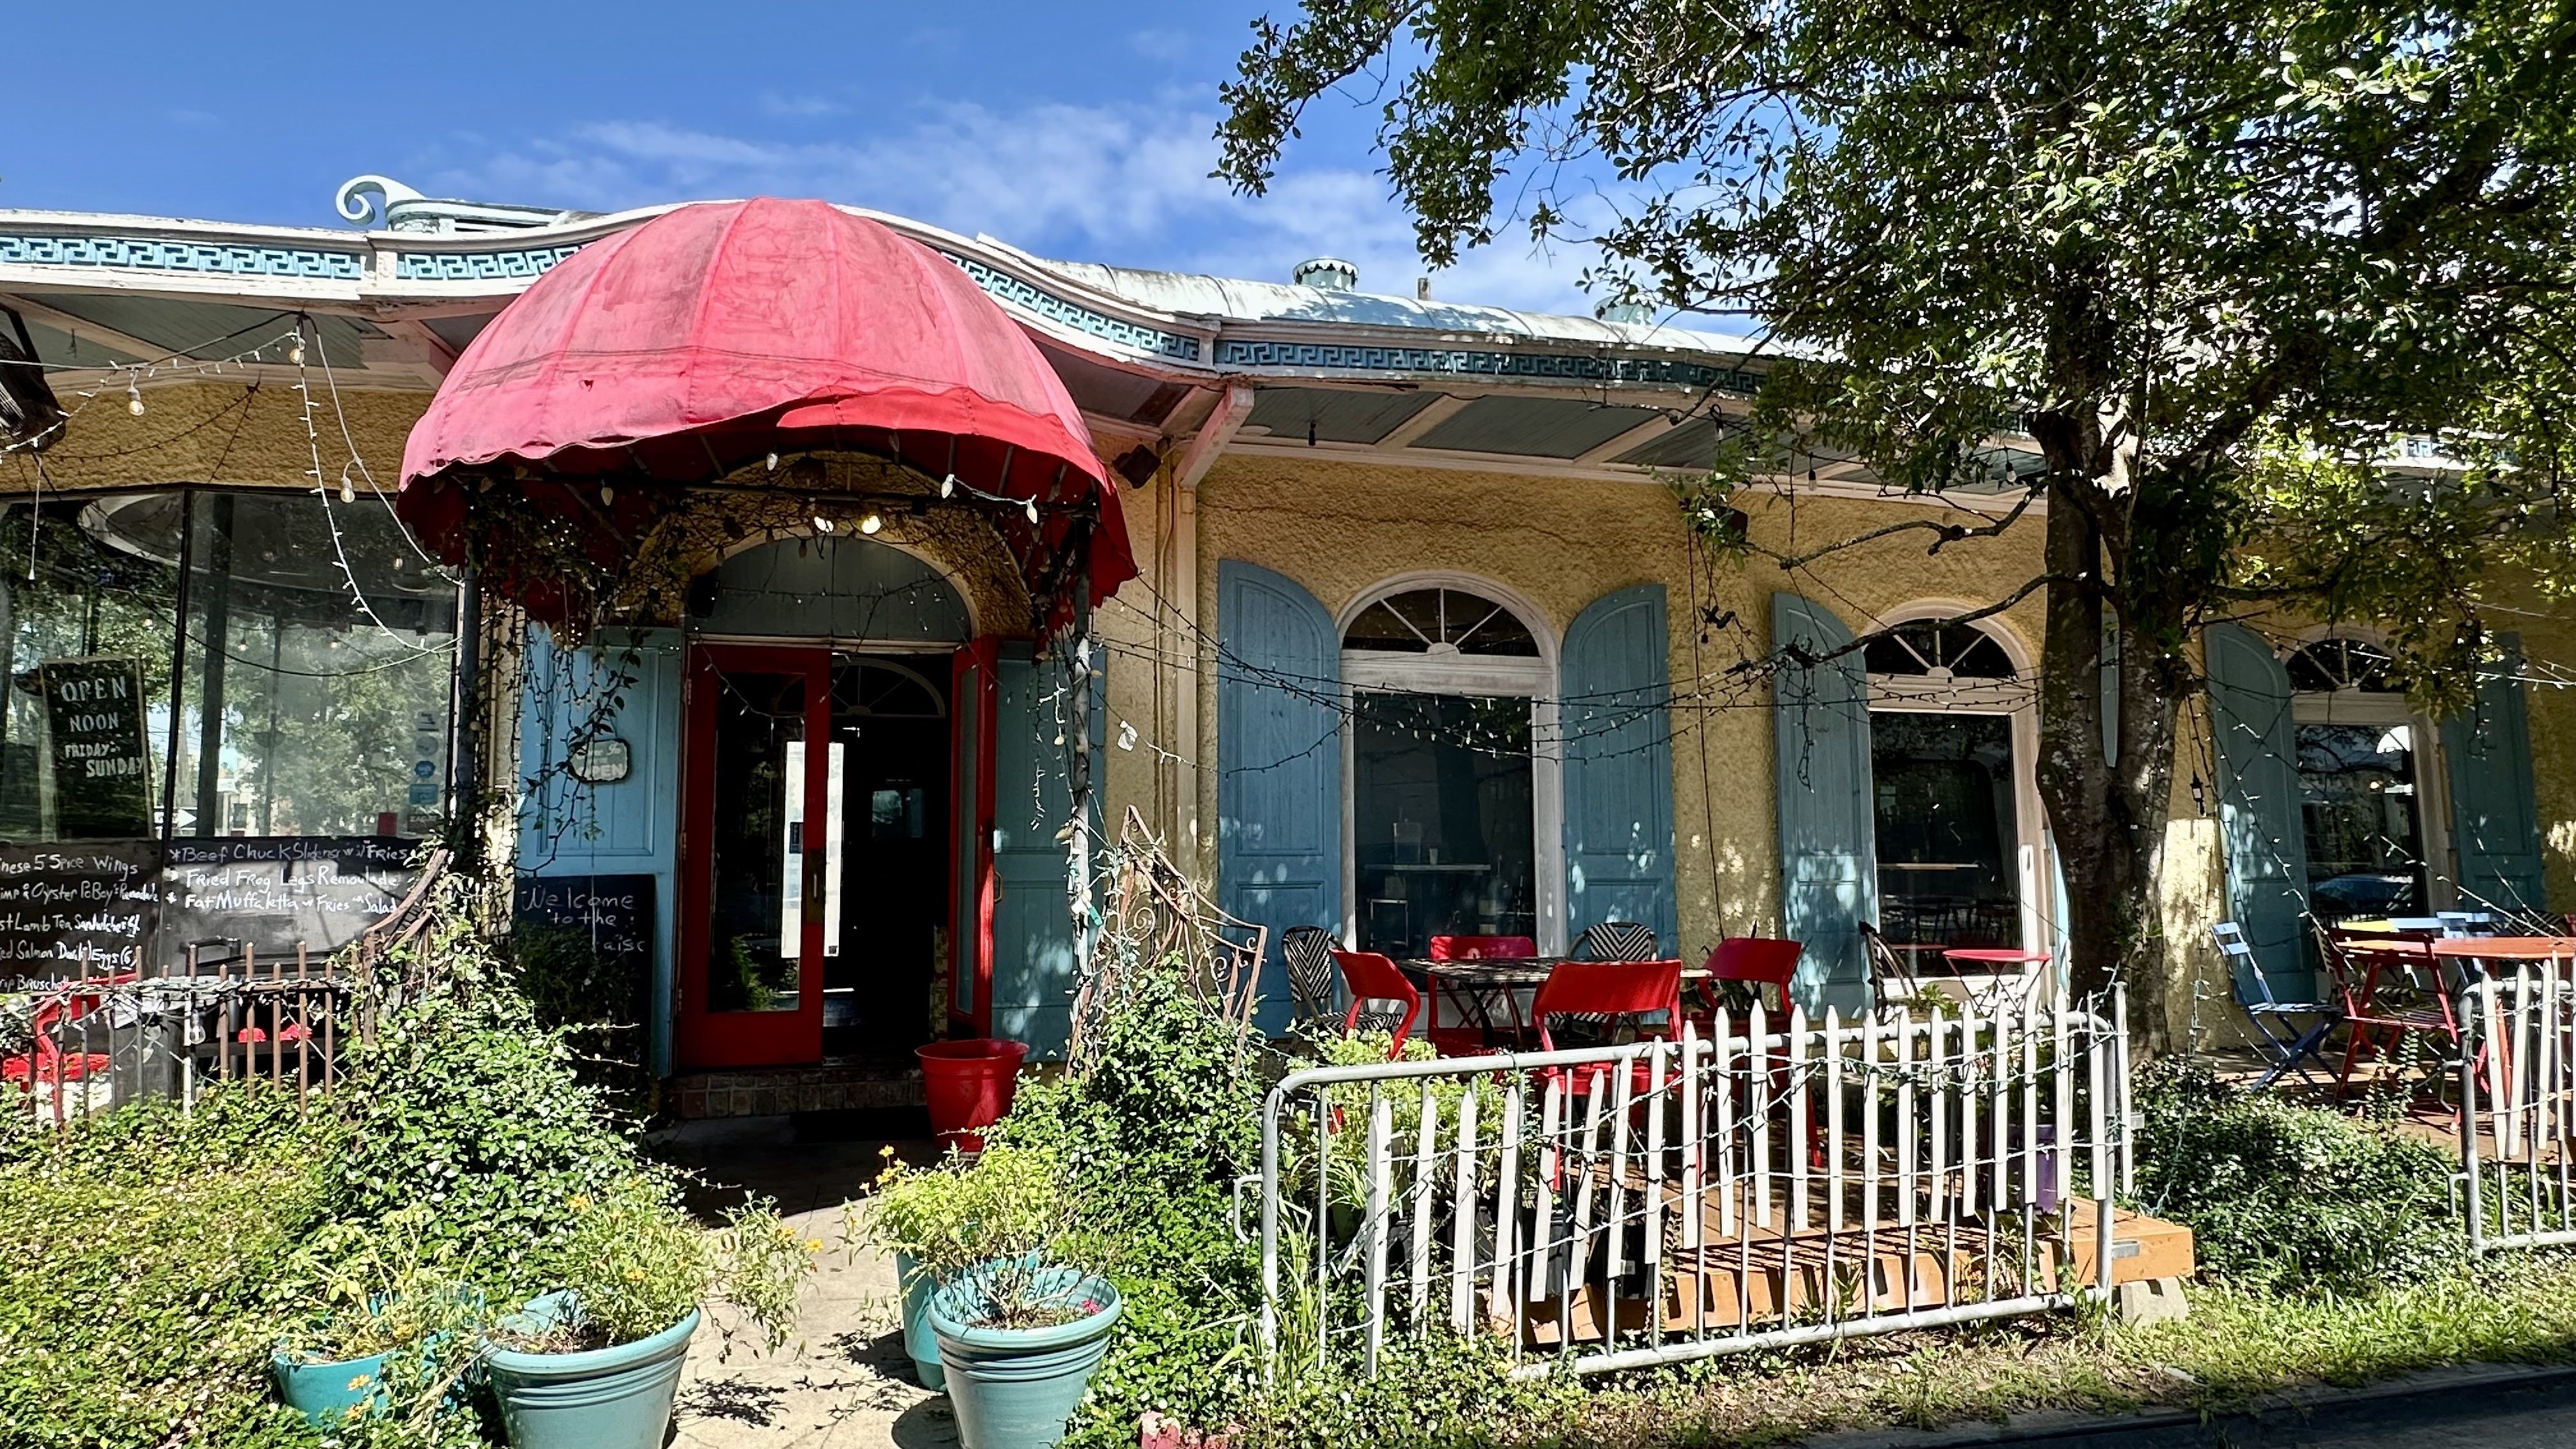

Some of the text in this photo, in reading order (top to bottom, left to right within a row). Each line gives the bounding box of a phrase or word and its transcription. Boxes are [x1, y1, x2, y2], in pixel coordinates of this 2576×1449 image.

[61, 676, 126, 702] OPEN
[70, 712, 119, 732] NOON
[86, 756, 143, 778] SUNDAY
[181, 846, 229, 863] Beef
[34, 854, 47, 870] 5
[92, 855, 138, 882] Wings
[31, 882, 77, 905] Oyster
[362, 892, 397, 914] Salad
[521, 885, 638, 911] Welcome
[15, 911, 51, 932] Lamb
[52, 914, 73, 931] Tea
[550, 907, 617, 926] to the
[15, 939, 54, 959] Salmon
[91, 948, 119, 970] Eggs
